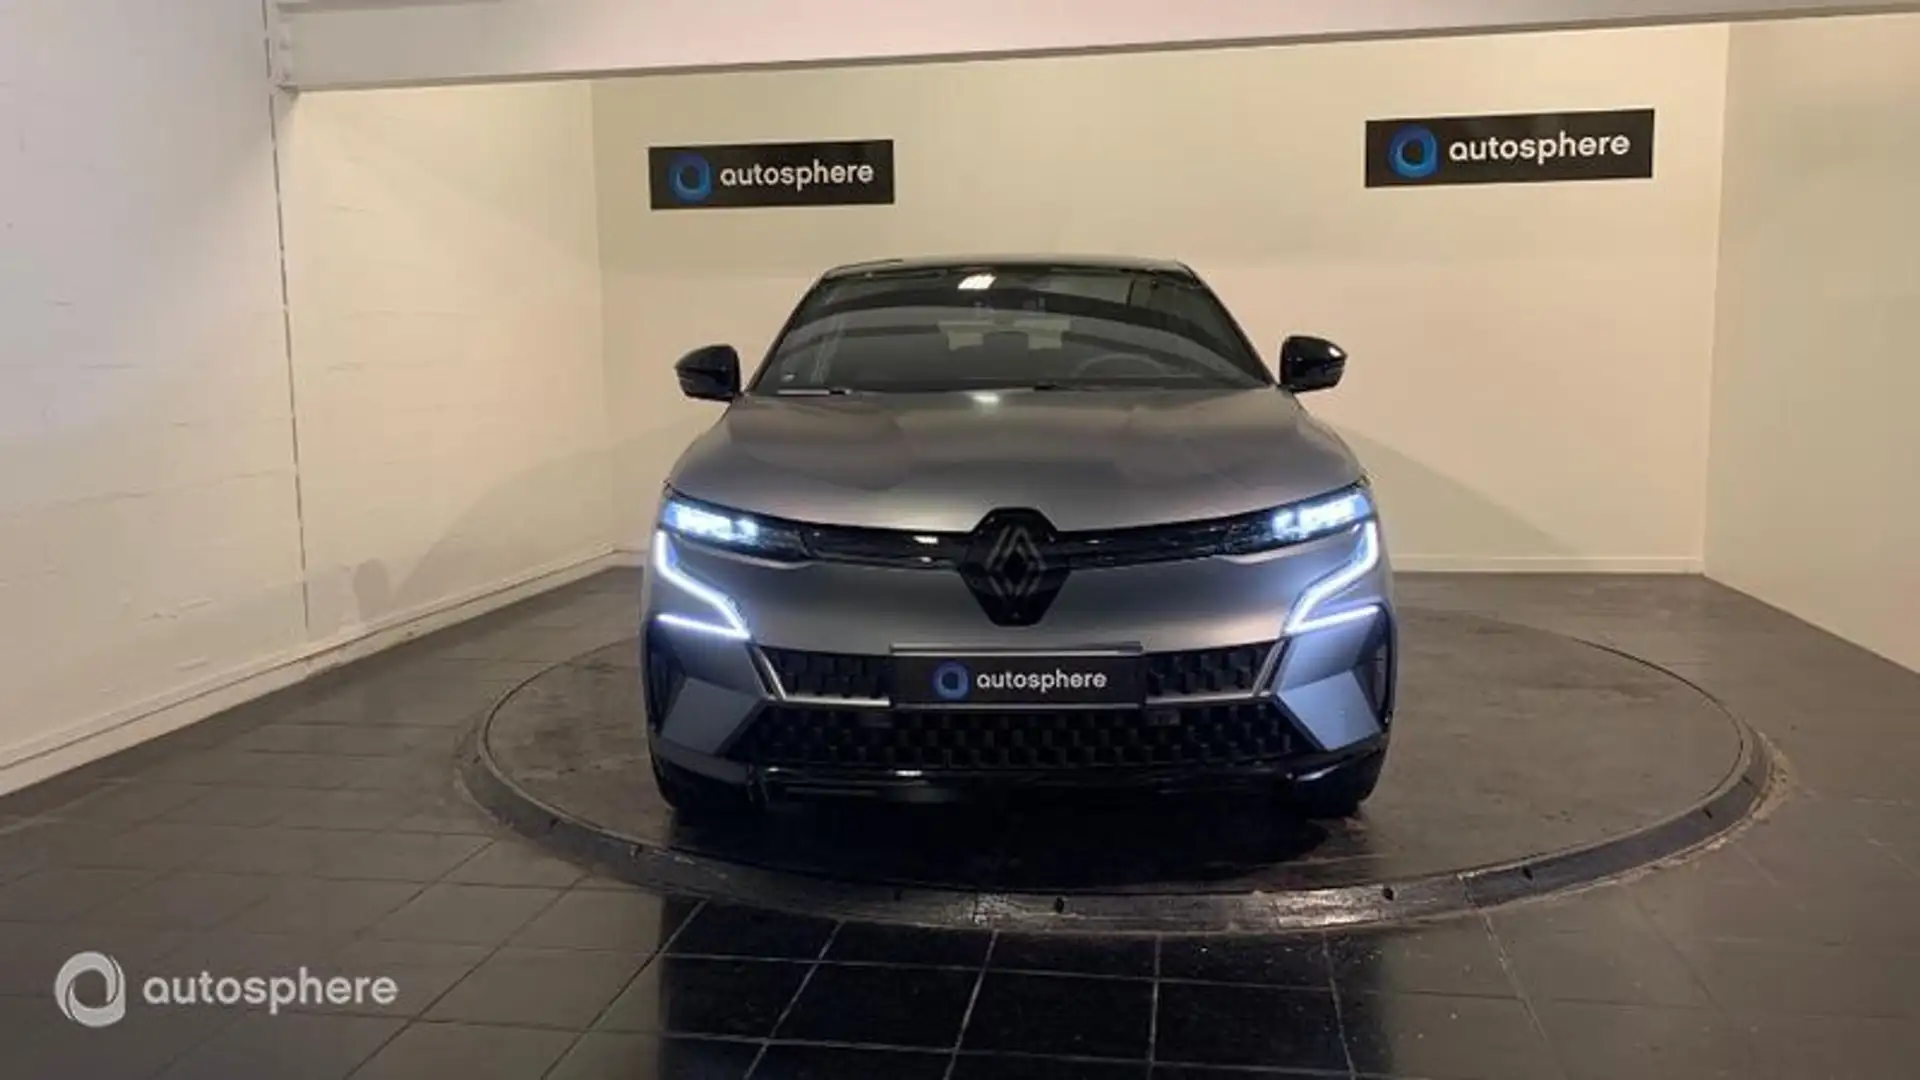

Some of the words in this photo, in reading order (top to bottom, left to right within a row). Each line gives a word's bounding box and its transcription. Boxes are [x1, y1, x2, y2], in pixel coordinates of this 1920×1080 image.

[1449, 130, 1631, 165] autosphere
[719, 159, 874, 192] autosphere
[976, 668, 1107, 693] autosphere
